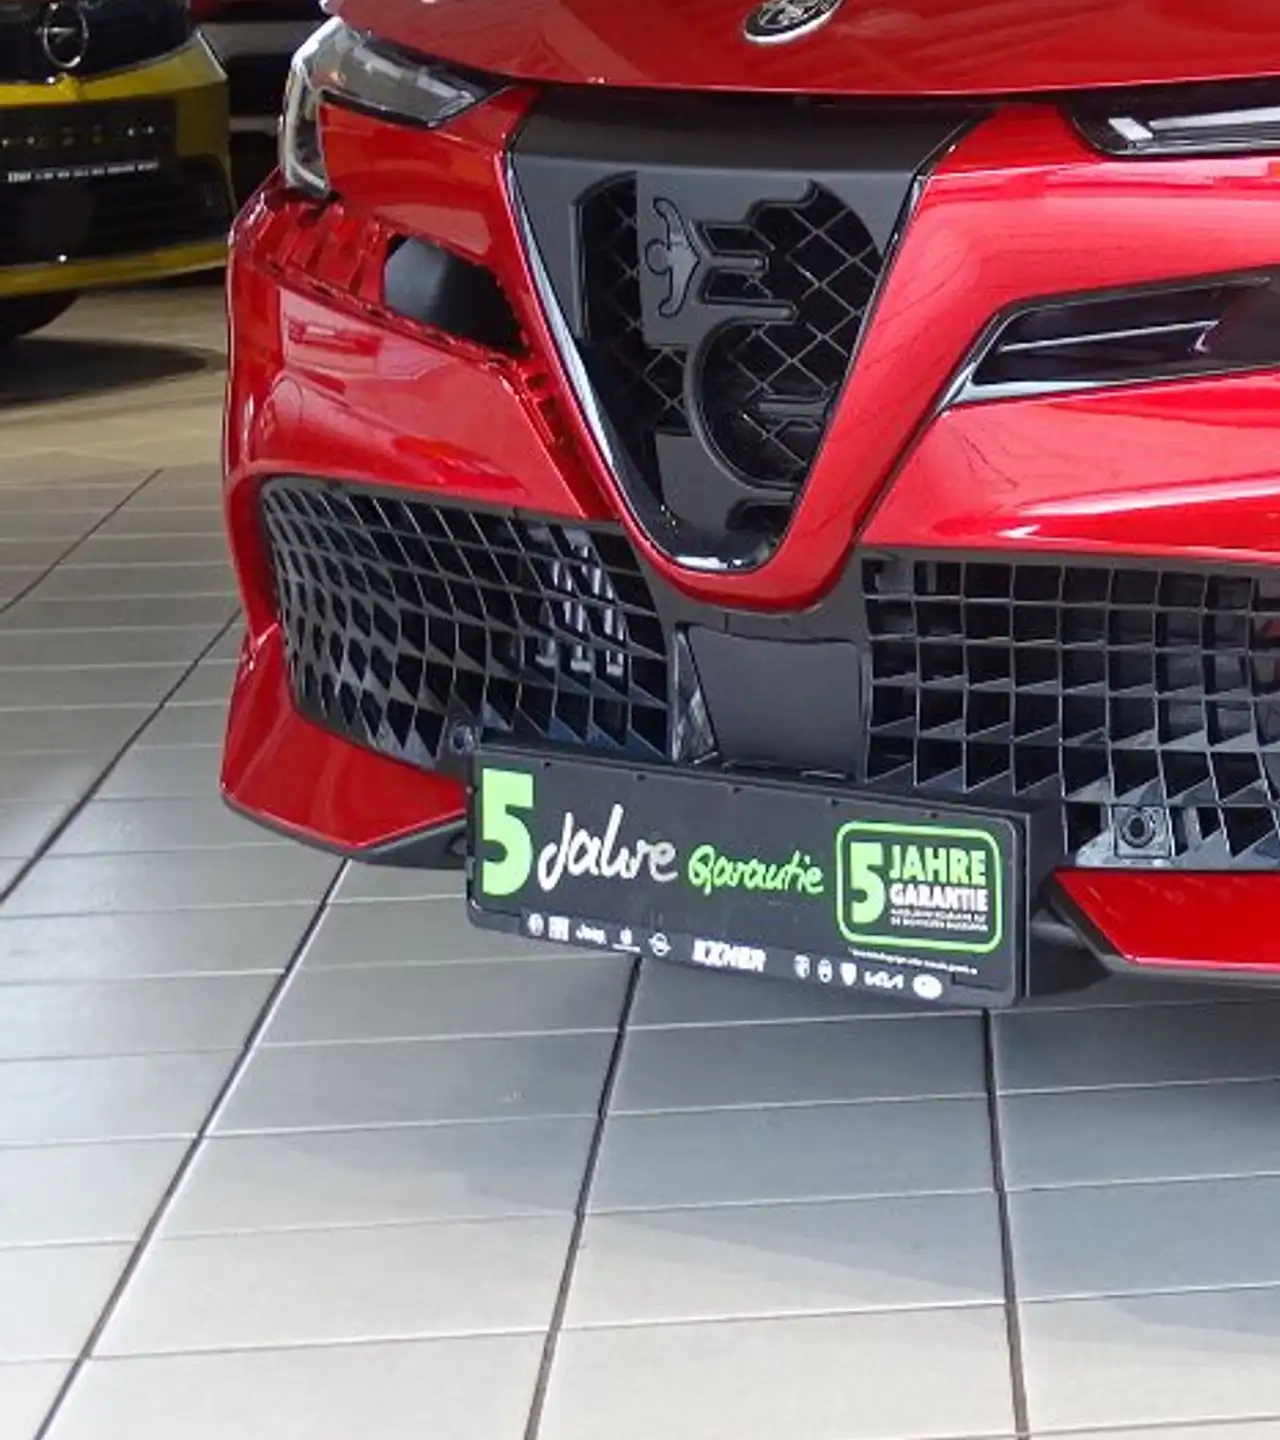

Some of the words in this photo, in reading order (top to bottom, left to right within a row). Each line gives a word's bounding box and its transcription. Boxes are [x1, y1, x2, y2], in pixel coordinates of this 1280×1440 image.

[482, 767, 534, 897] 5
[537, 803, 680, 893] Jahre
[687, 843, 825, 896] Garantie
[850, 841, 886, 924] 5
[889, 844, 987, 886] JAHRE
[889, 882, 989, 911] GARANTIE
